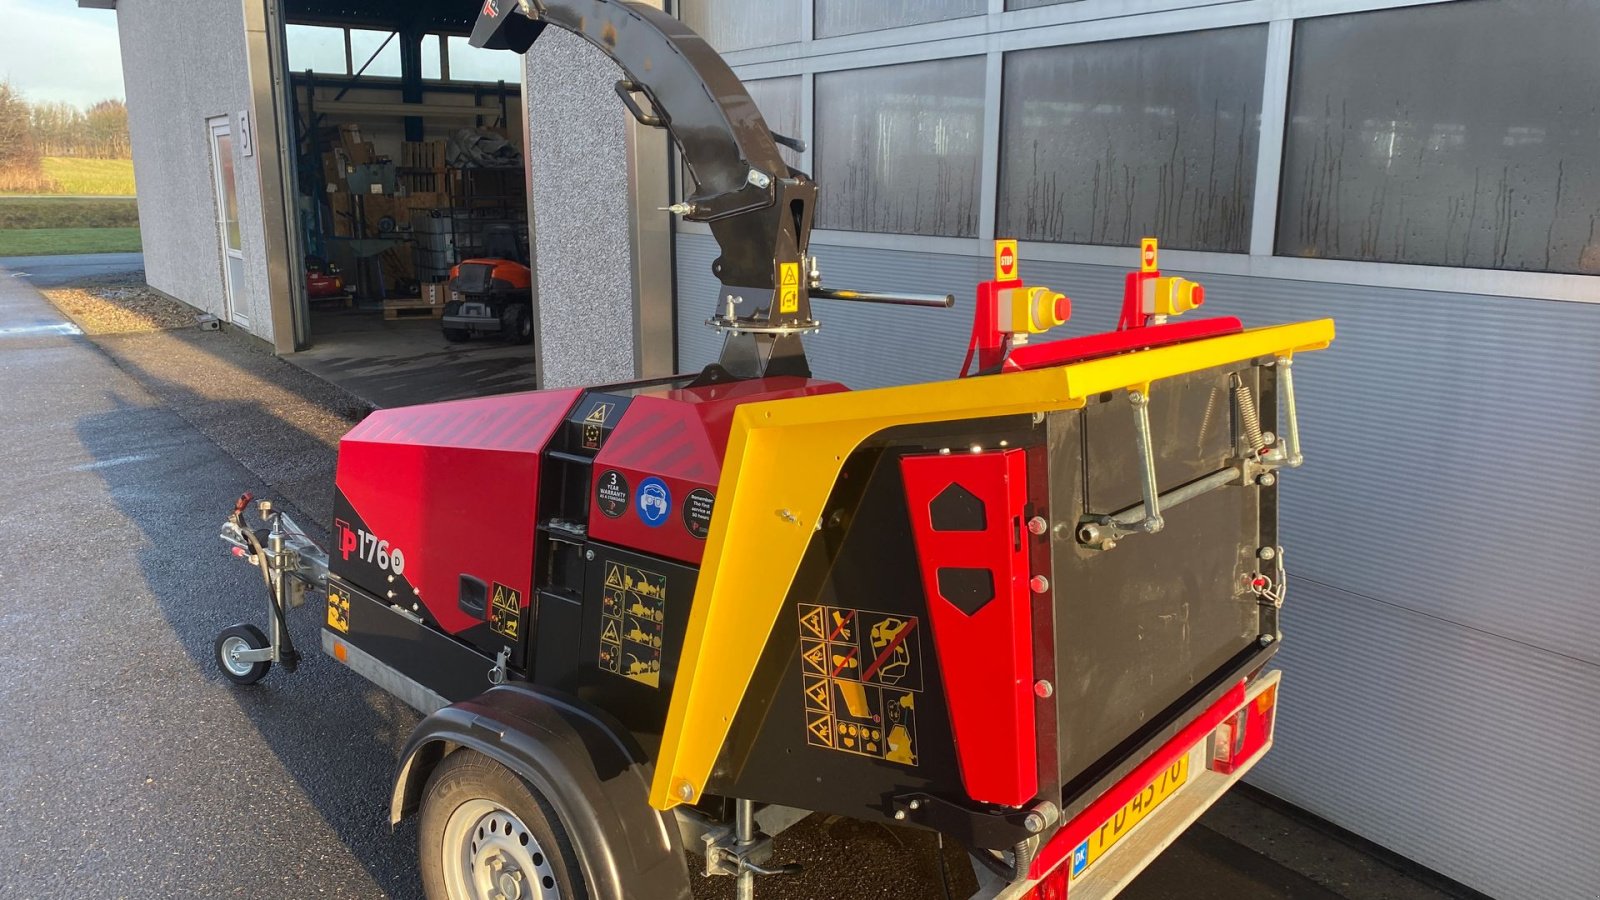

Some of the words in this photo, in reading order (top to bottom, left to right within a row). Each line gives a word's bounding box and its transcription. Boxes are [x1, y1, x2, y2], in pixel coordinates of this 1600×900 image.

[1001, 255, 1013, 266] STOP
[1145, 251, 1154, 260] STOP
[610, 473, 617, 485] 3
[600, 488, 626, 498] WARRANTY
[358, 529, 389, 570] 176
[1075, 848, 1085, 865] DK
